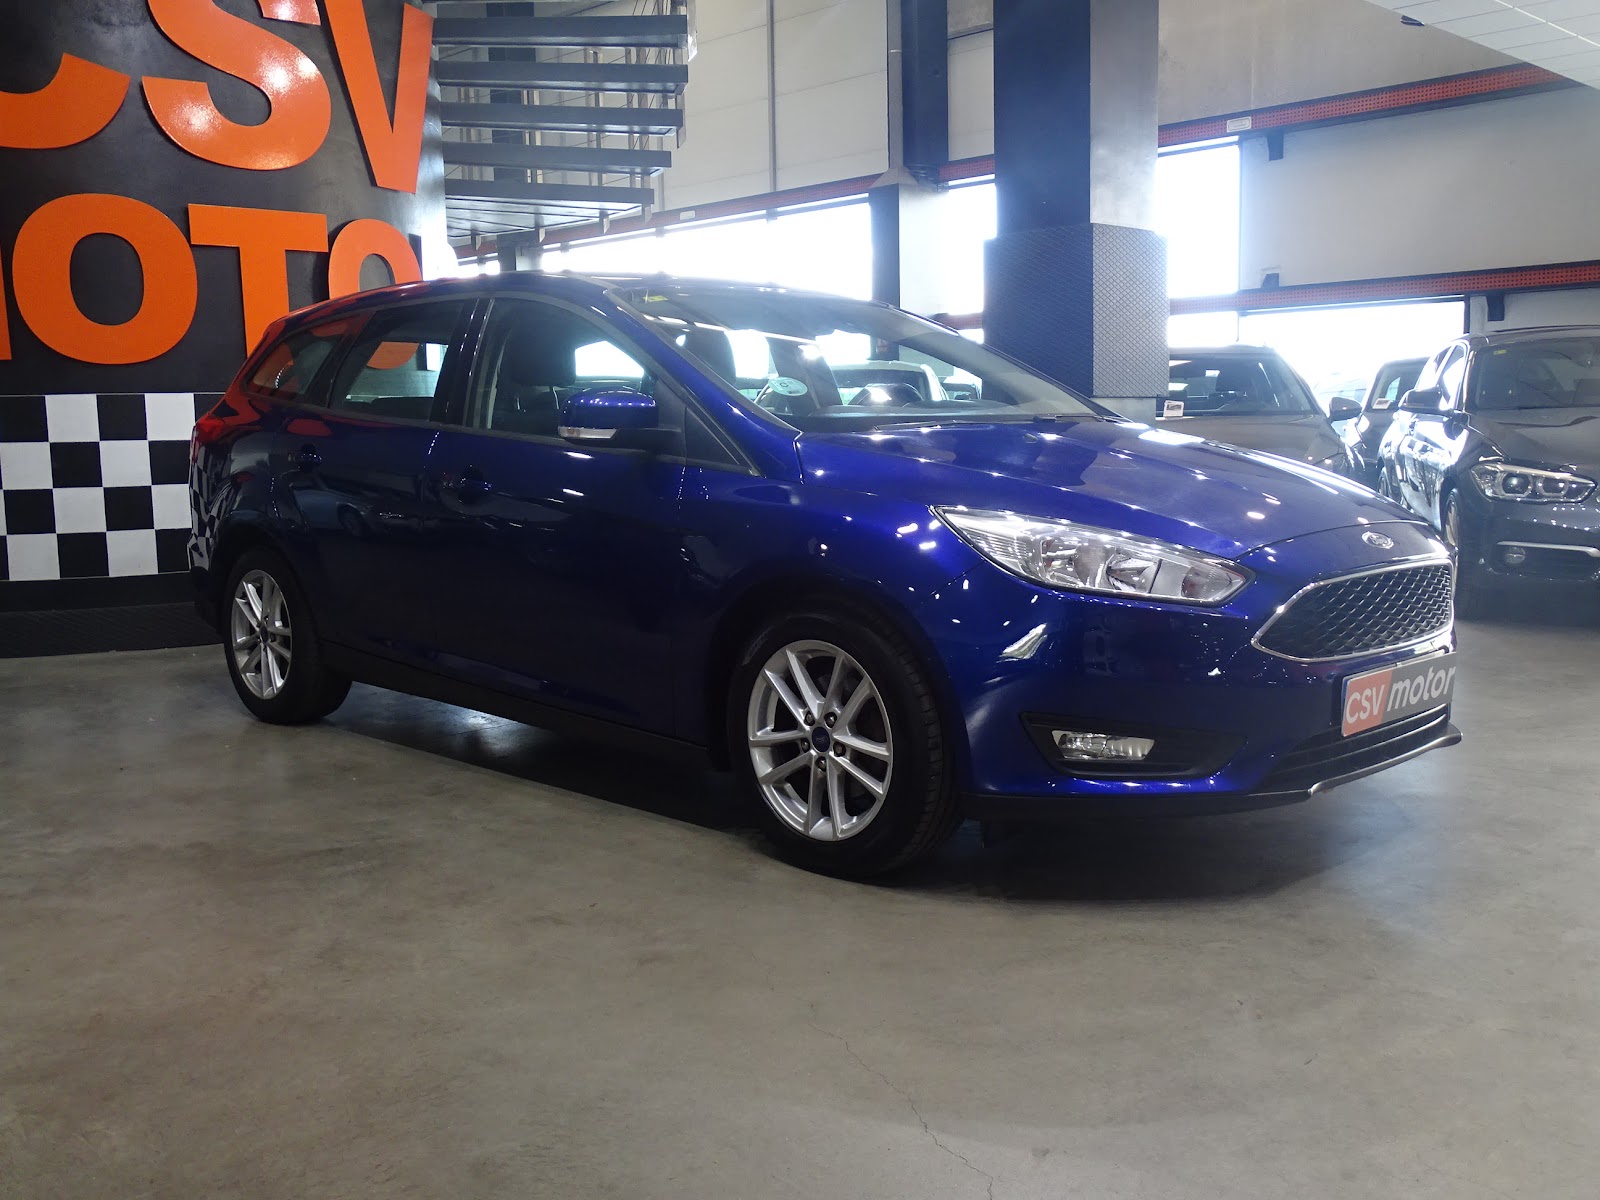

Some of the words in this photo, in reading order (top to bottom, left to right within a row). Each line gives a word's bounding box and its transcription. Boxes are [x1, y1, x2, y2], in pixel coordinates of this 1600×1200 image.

[0, 193, 430, 369] OTO
[1346, 686, 1384, 724] CSV
[1388, 665, 1456, 711] motor
